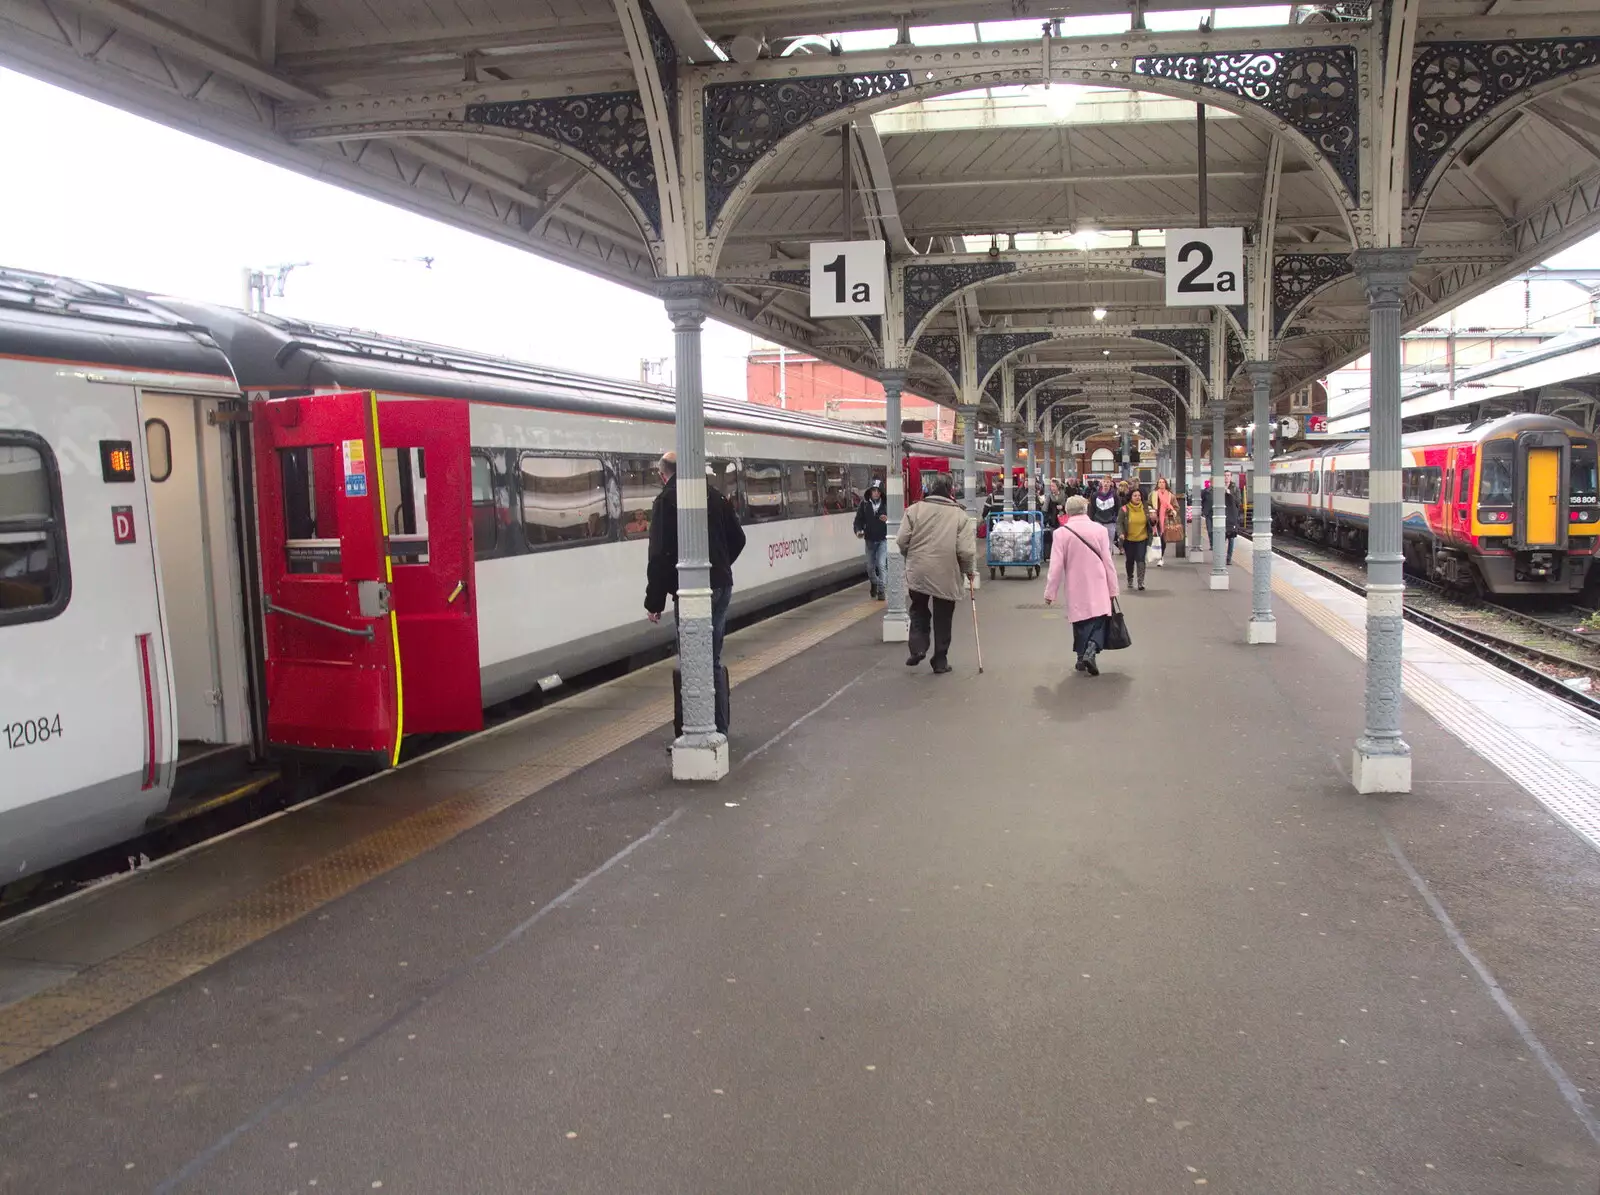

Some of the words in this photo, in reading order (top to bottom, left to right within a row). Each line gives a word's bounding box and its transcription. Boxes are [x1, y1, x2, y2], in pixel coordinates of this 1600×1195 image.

[823, 254, 870, 303] 1a
[1177, 241, 1236, 293] 2a
[1075, 443, 1084, 452] 1b
[116, 515, 129, 538] D
[768, 532, 808, 568] greateranglia
[2, 713, 63, 749] 12084
